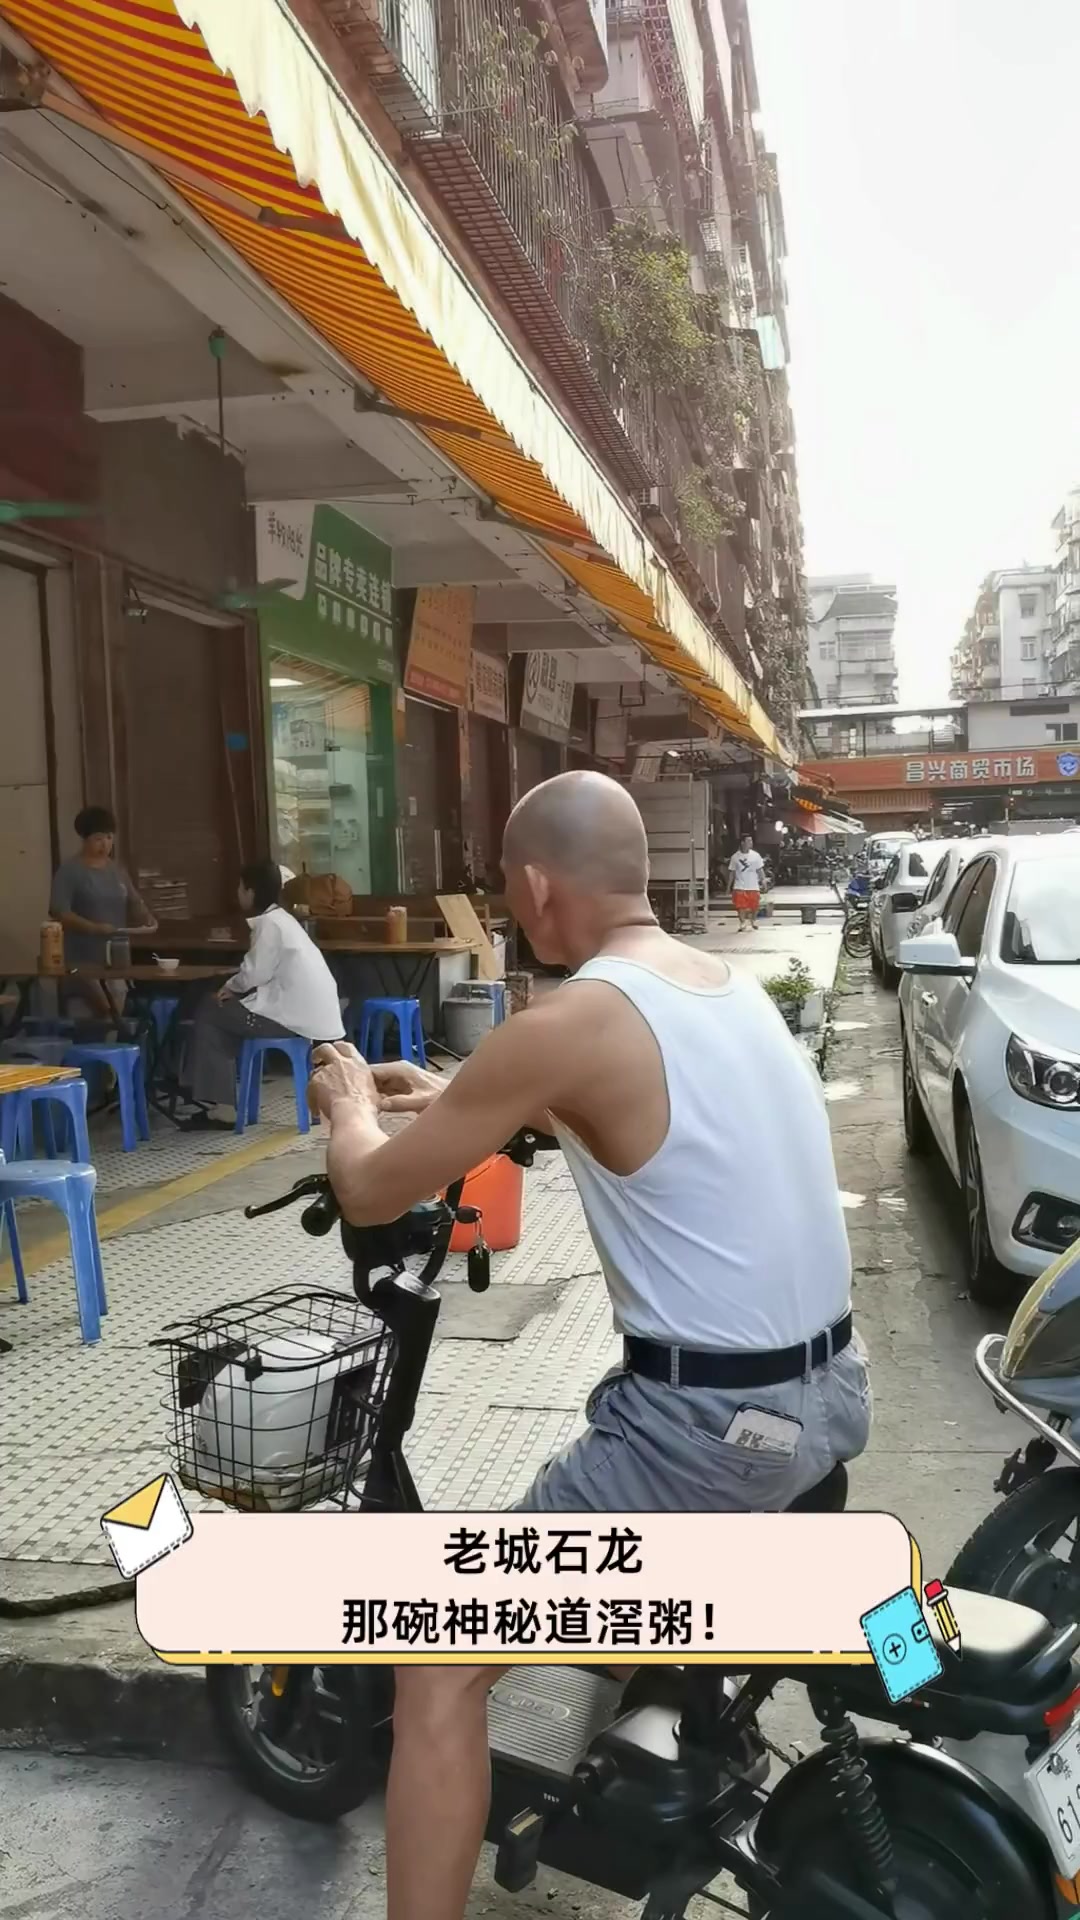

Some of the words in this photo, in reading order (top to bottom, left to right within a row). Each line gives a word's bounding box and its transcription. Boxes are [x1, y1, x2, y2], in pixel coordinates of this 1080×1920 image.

[906, 756, 1035, 782] 昌兴商贸市场
